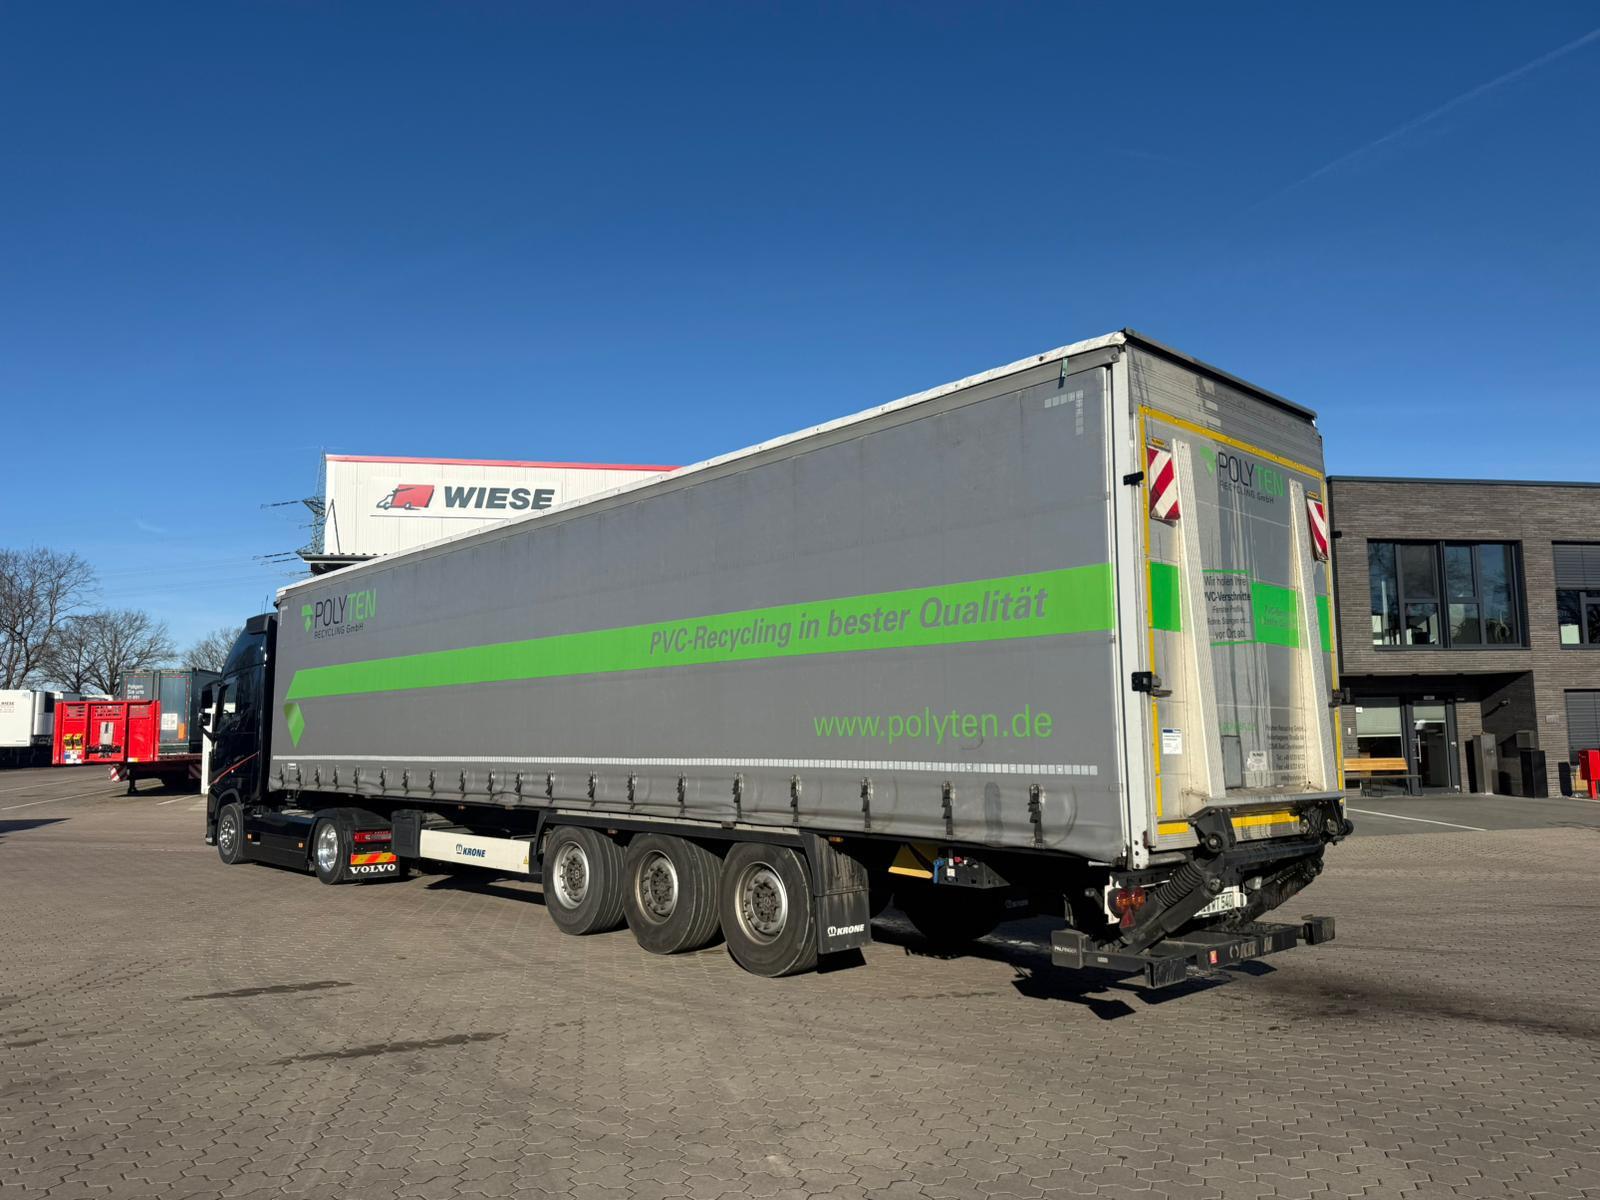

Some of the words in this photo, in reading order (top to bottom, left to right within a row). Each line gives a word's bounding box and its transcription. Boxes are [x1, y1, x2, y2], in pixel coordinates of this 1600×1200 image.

[1218, 451, 1285, 497] POLYTEN
[444, 486, 555, 510] WIESE
[314, 588, 377, 629] POLYTEN
[649, 619, 792, 655] PVC-Recycling
[798, 612, 820, 640] in
[826, 608, 910, 637] bester
[919, 586, 1049, 629] Qualität
[813, 704, 1054, 744] www.polyten.de
[462, 847, 486, 858] KRONE
[350, 864, 396, 874] VOLVO
[836, 924, 865, 935] KRONE
